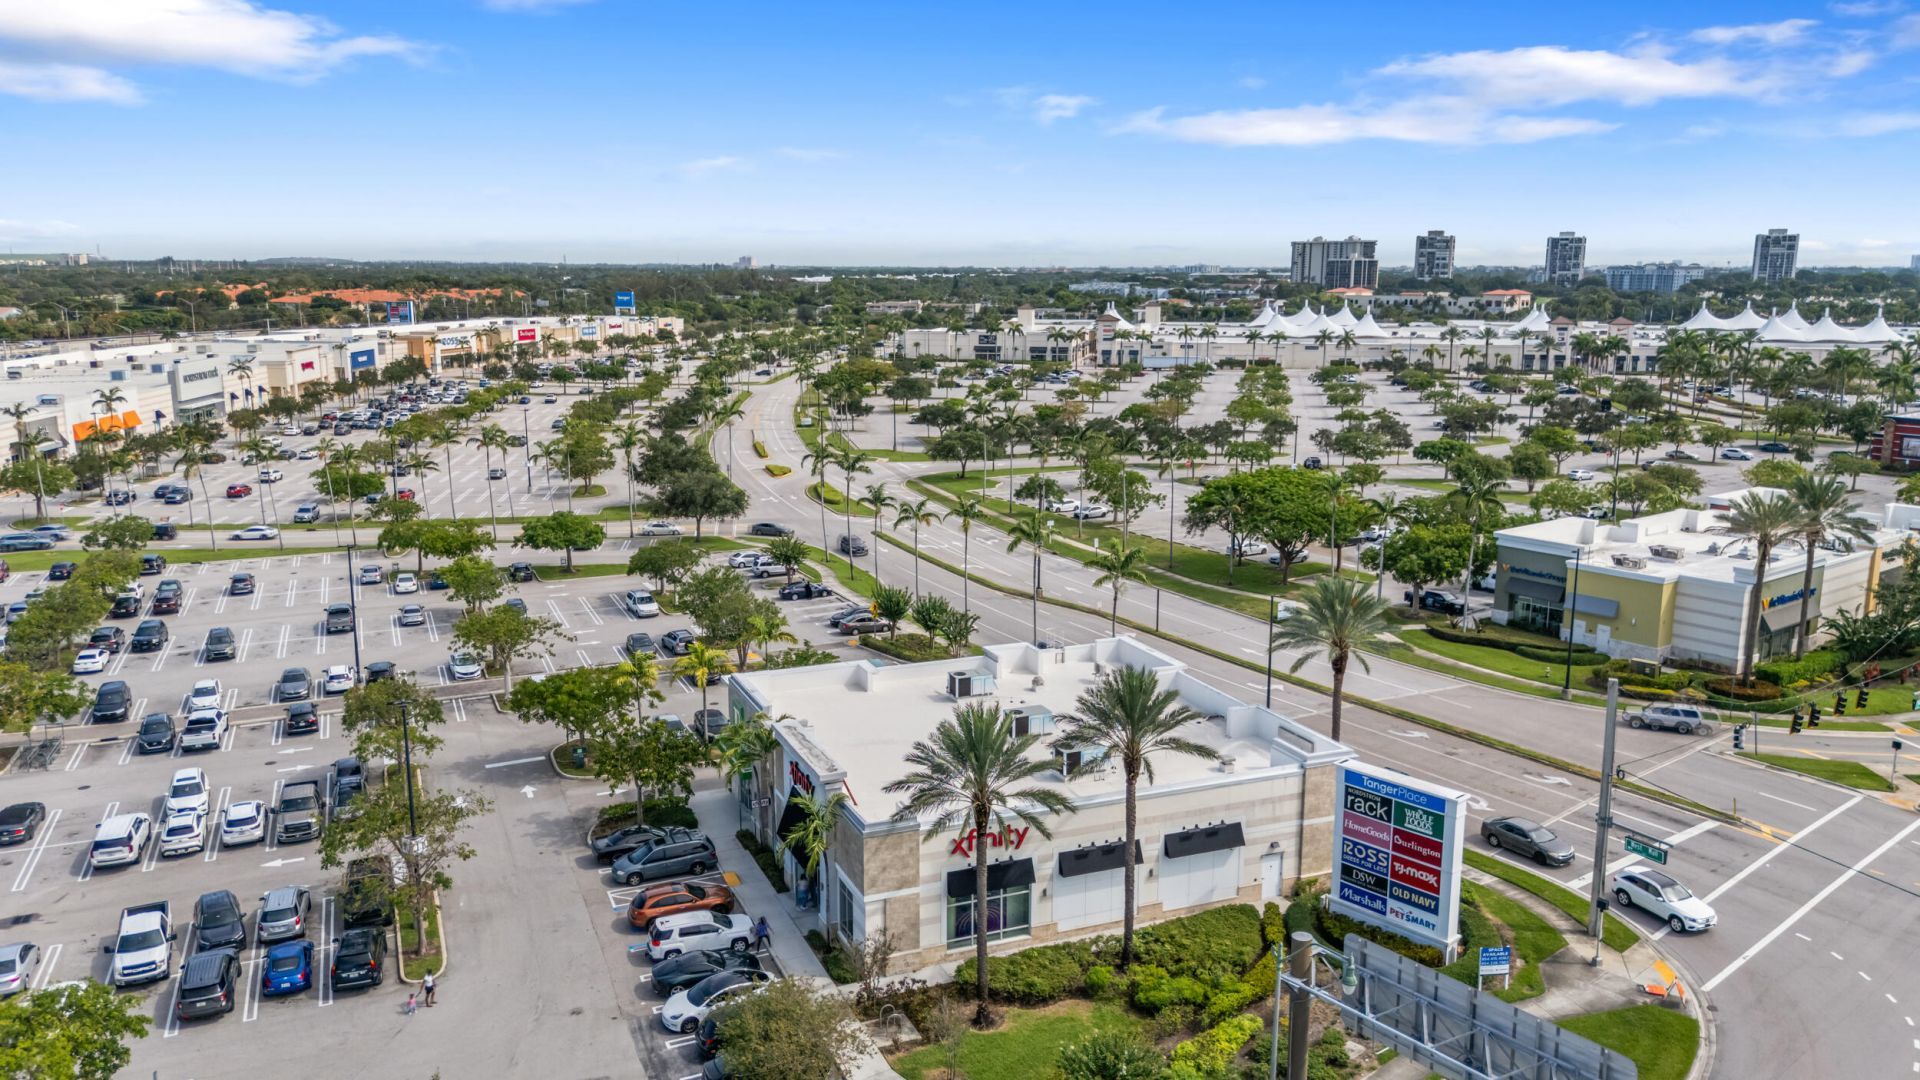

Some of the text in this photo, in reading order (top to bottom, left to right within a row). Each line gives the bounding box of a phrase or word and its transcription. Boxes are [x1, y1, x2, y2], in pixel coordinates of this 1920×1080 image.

[1347, 795, 1388, 820] rack
[1404, 808, 1434, 823] WHOLE
[1344, 818, 1390, 842] HomeGoods
[1405, 816, 1434, 831] FOODS
[1343, 841, 1388, 867] ROSS
[1394, 835, 1441, 858] Burlington
[1343, 854, 1388, 874] DRESS FOR LESS
[1352, 869, 1377, 885] DSW
[1340, 887, 1386, 913] Marshalls
[1392, 887, 1437, 910] OLD NAVY
